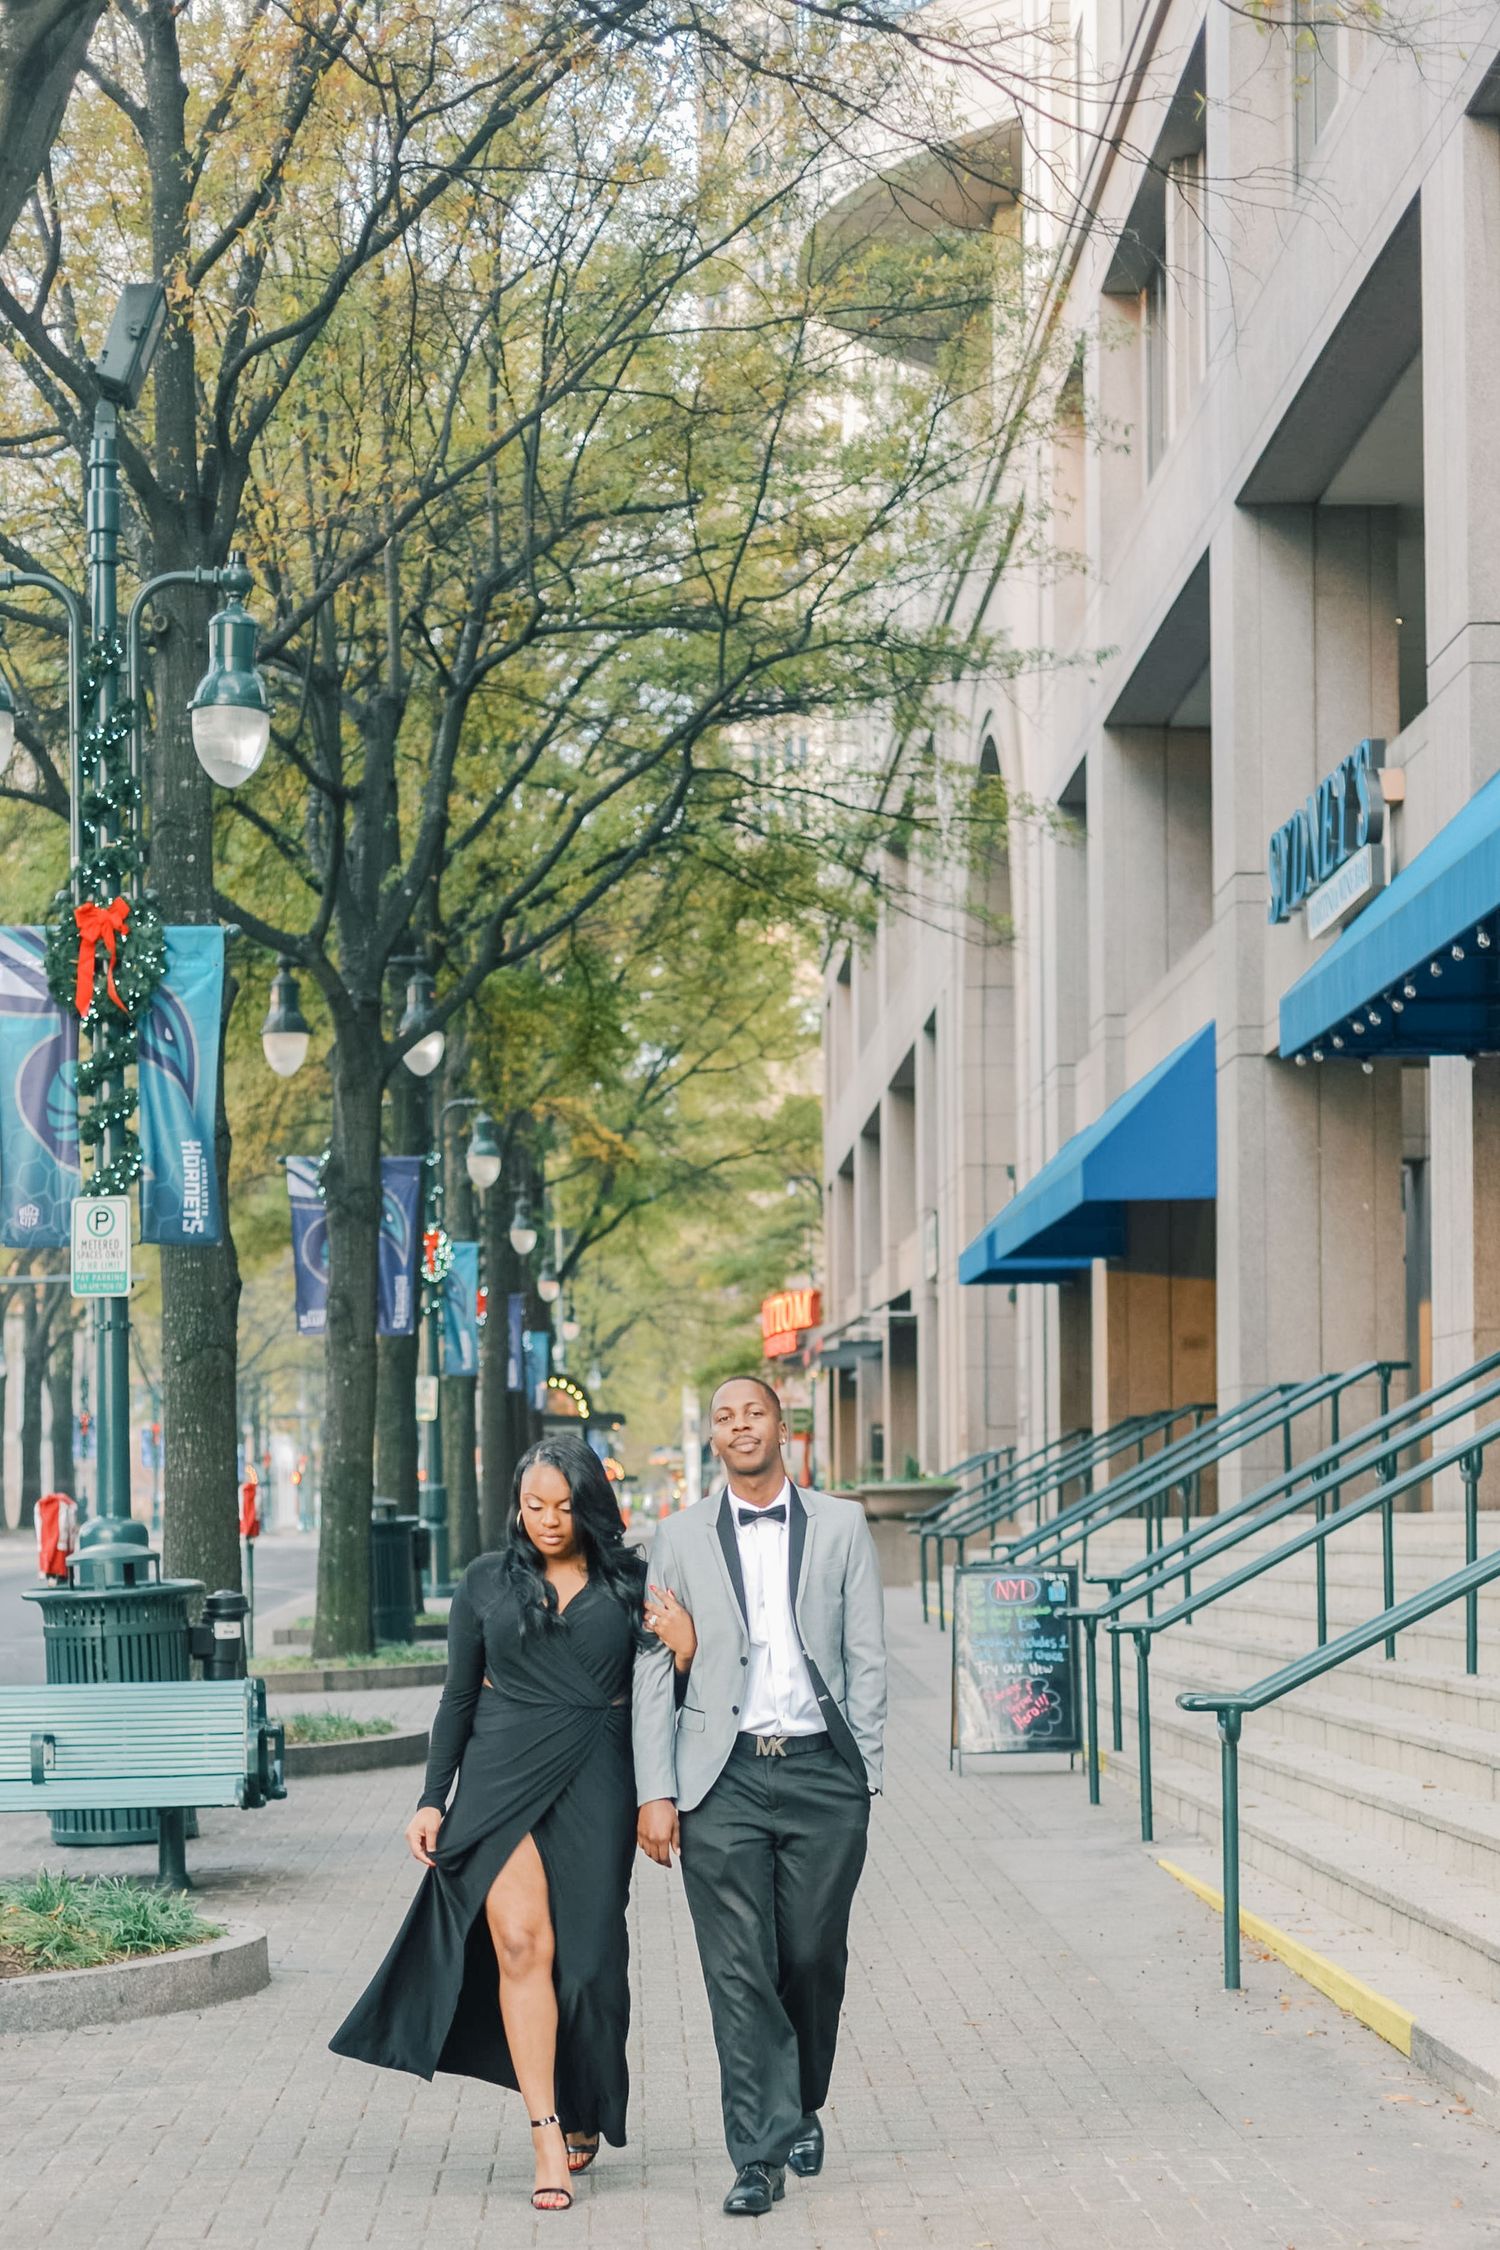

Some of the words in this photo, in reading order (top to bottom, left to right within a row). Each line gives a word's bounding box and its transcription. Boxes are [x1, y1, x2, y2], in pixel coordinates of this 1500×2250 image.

[180, 1139, 205, 1234] HORNETS
[95, 1211, 109, 1230] P
[81, 1239, 120, 1251] METERED
[77, 1250, 102, 1260] SPACES
[104, 1250, 124, 1260] ONLY
